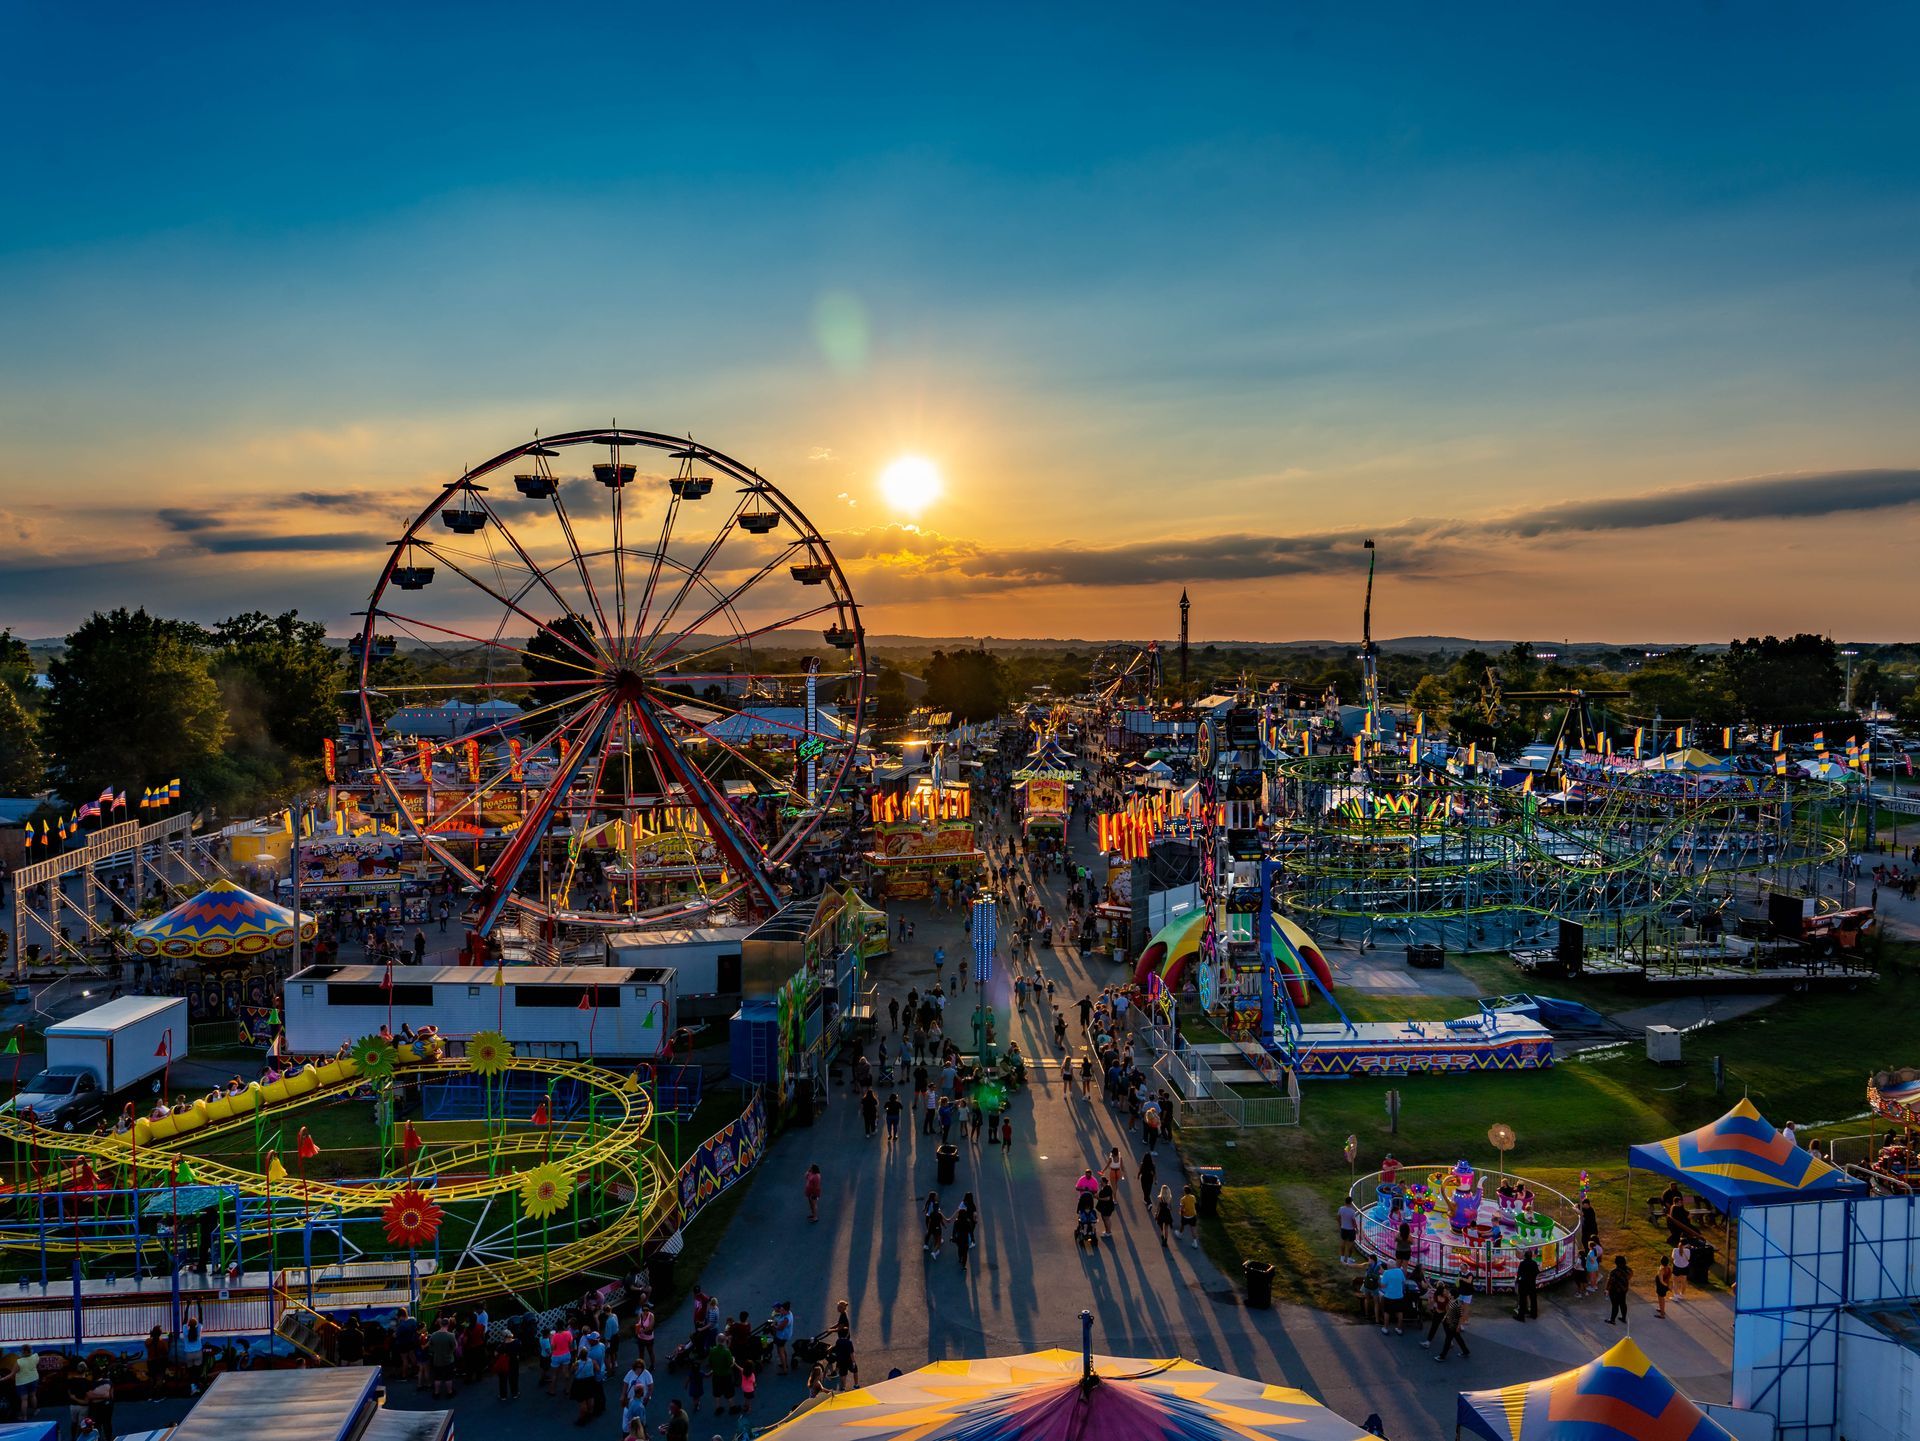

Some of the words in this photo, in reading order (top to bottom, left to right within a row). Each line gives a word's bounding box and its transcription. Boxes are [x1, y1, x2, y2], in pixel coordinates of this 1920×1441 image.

[1011, 770, 1082, 781] LEMONADE
[483, 796, 518, 809] ROASTED
[313, 848, 328, 857] THE
[1358, 1055, 1474, 1067] ZIPPER
